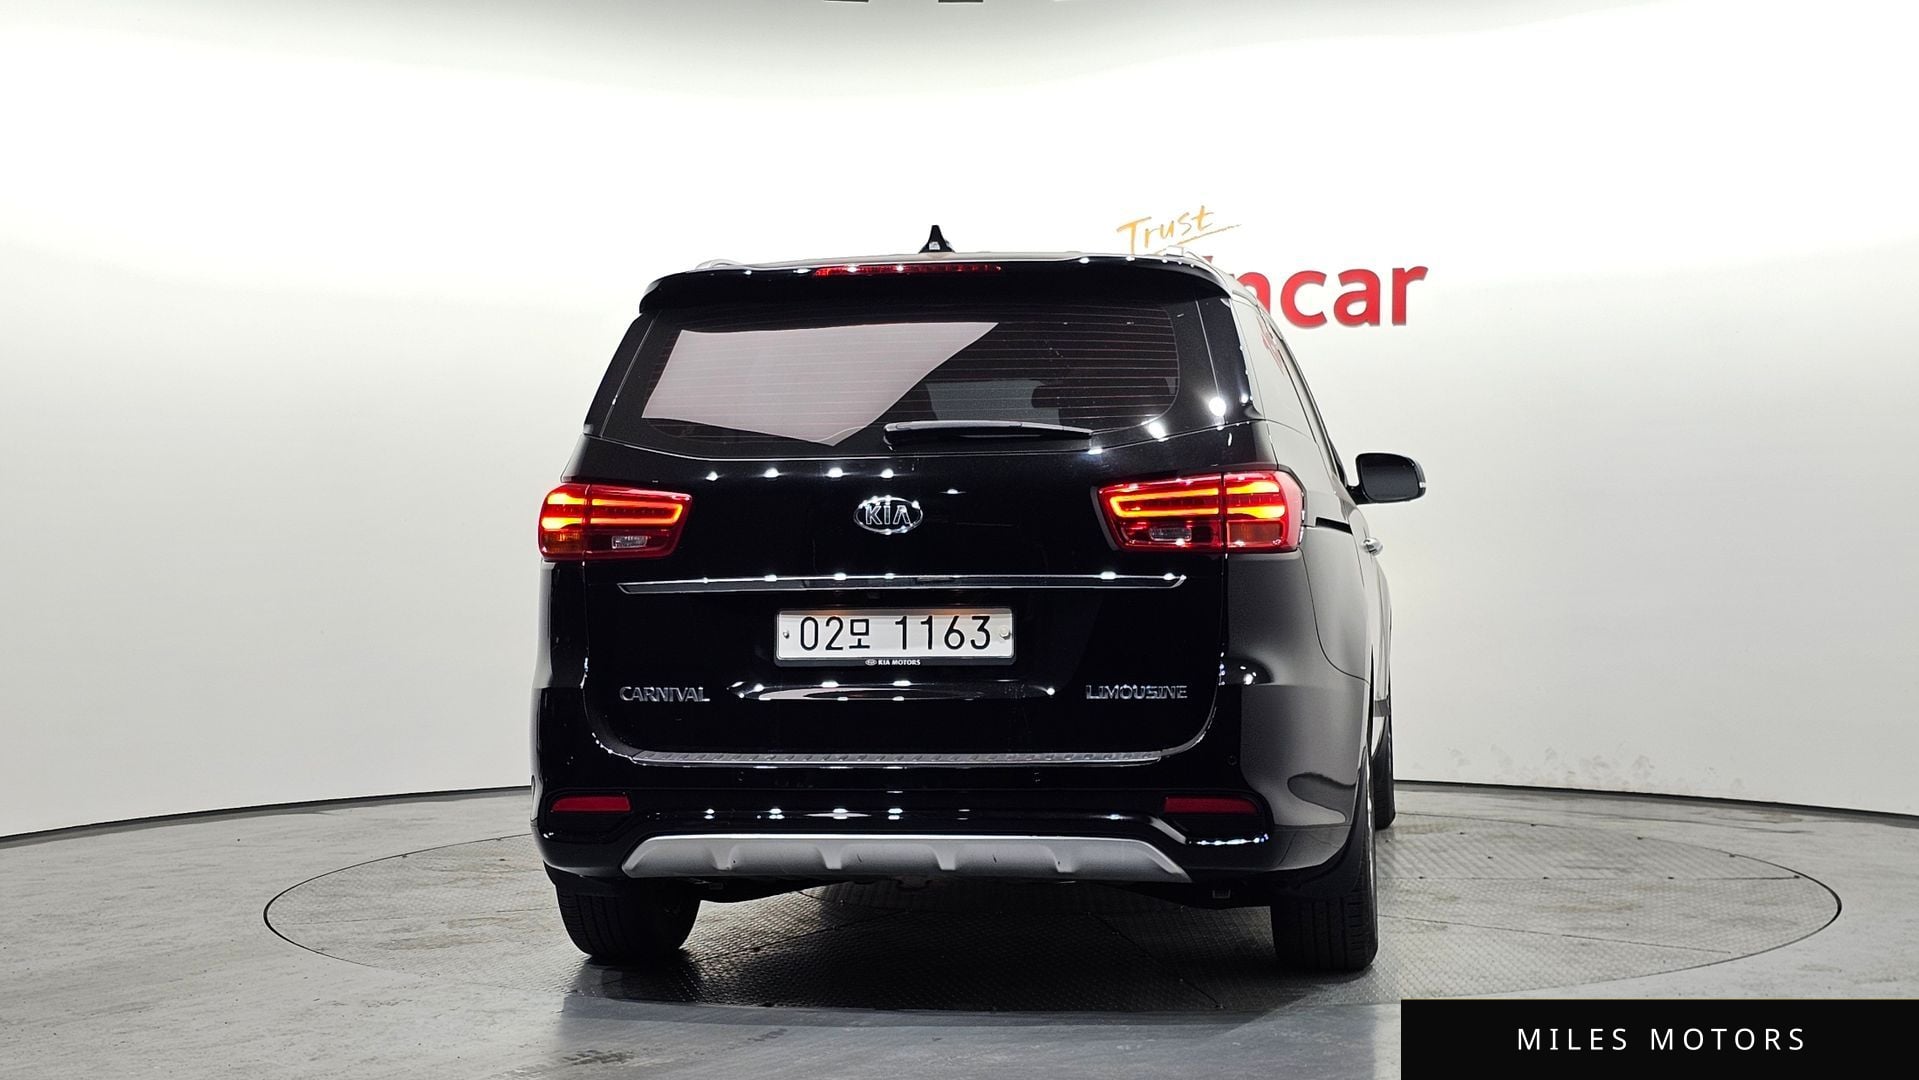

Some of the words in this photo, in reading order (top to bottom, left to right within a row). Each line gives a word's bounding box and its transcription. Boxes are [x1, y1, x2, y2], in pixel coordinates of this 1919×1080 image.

[1116, 205, 1215, 256] Trust
[1203, 255, 1429, 329] ncar
[865, 503, 911, 525] KIA
[799, 616, 871, 651] 02모
[895, 615, 991, 651] 1163
[619, 686, 711, 702] CARNIVAL
[1085, 684, 1188, 700] LIMOUSINE
